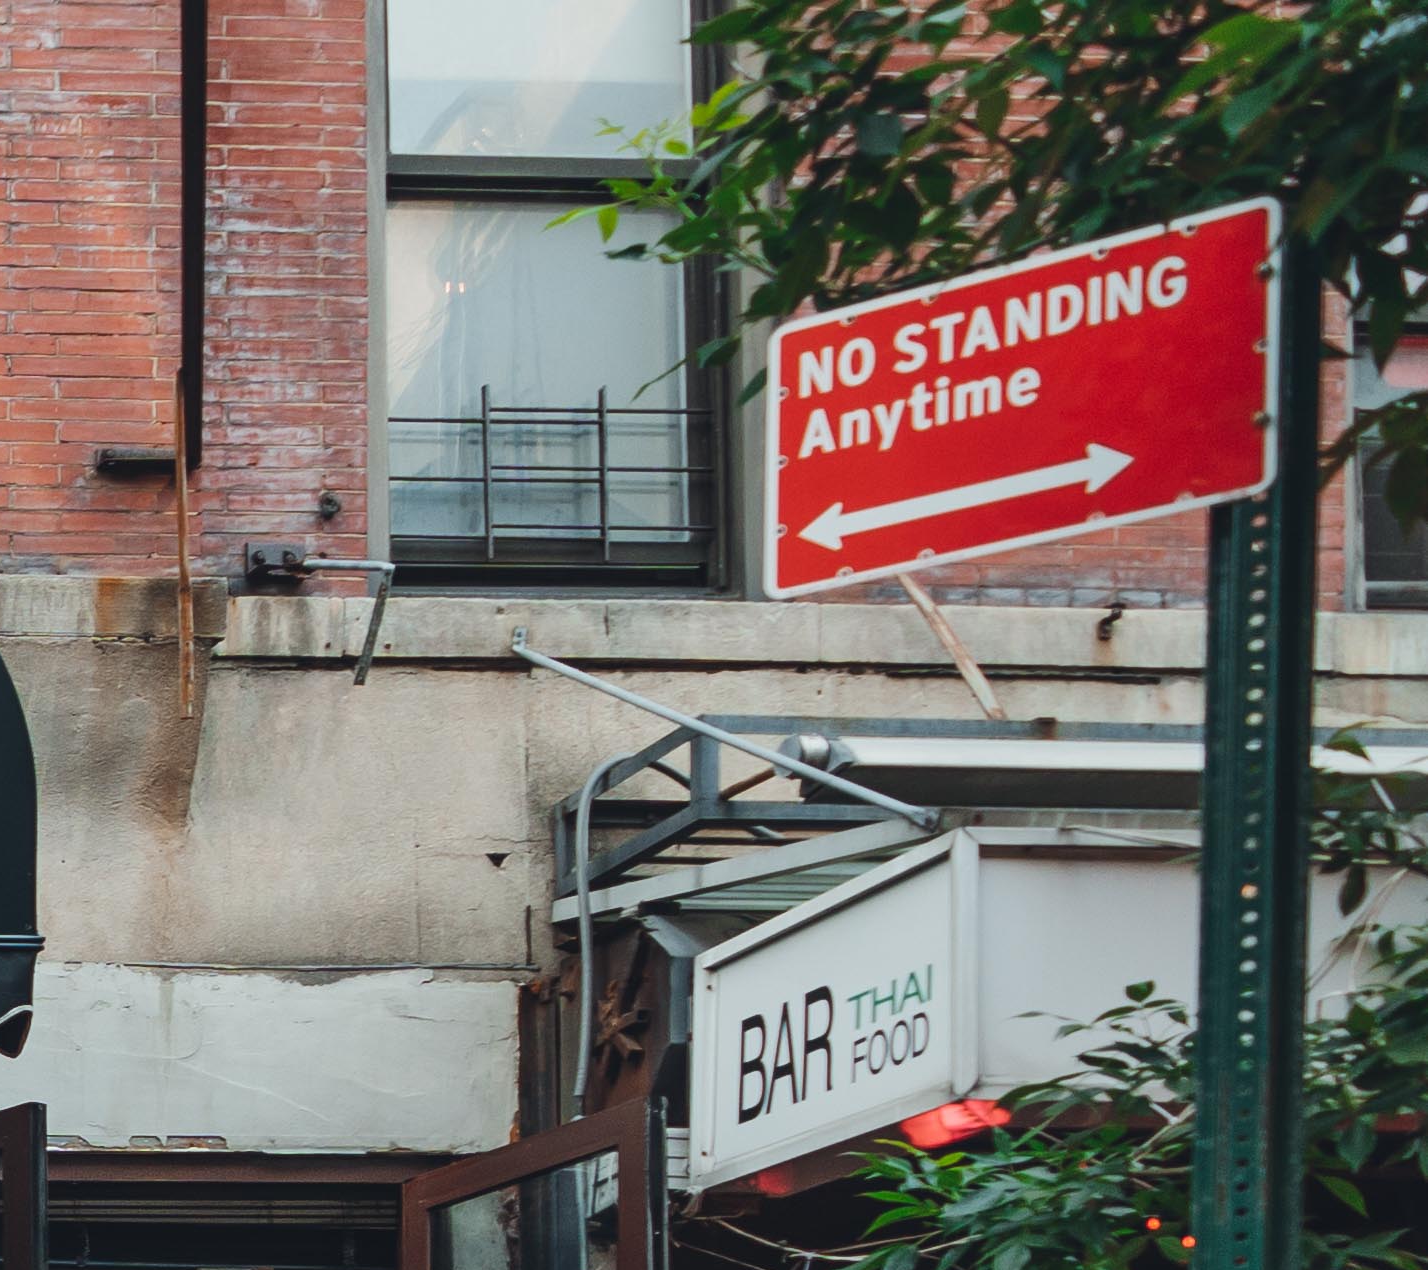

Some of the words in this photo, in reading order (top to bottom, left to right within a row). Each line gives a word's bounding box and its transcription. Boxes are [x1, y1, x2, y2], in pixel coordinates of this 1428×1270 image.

[797, 336, 877, 399] NO
[892, 255, 1188, 374] STANDING
[797, 366, 1042, 460] Anytime
[846, 963, 933, 1030] THAI
[738, 985, 833, 1124] BAR
[851, 1012, 930, 1083] FOOD
